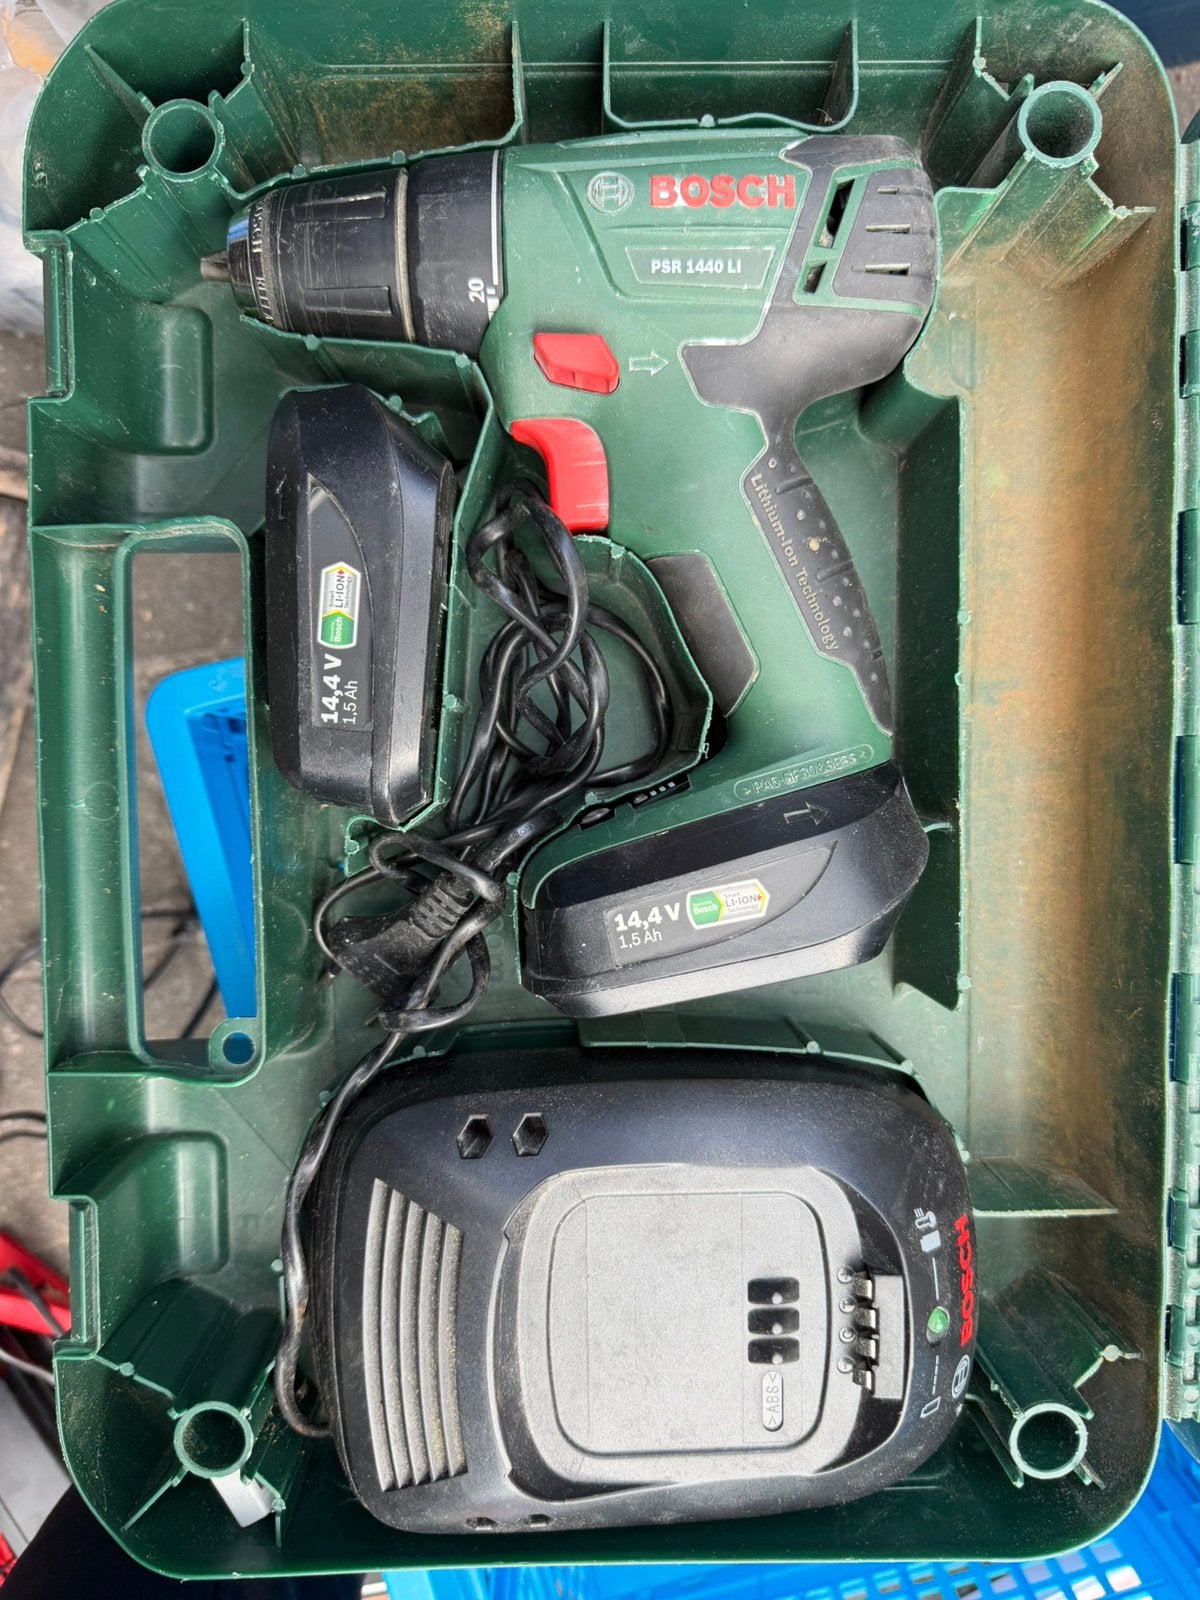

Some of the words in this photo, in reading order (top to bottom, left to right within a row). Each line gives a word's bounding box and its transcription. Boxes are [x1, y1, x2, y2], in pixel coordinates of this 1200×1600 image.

[649, 174, 796, 209] BOSCH
[651, 258, 682, 274] PSR
[686, 258, 724, 274] 1440
[727, 259, 742, 274] LI
[468, 277, 485, 304] 20
[750, 472, 799, 568] Lithium-Ion
[795, 565, 840, 650] Technology
[334, 616, 343, 643] Bosch
[323, 652, 342, 671] V
[320, 674, 344, 724] 14,4
[344, 680, 359, 700] Ah
[342, 702, 358, 725] 1,5
[614, 906, 663, 932] 14,4
[664, 902, 681, 921] V
[692, 903, 719, 914] Bosch
[618, 932, 642, 949] 1,5
[644, 928, 663, 944] Ah
[953, 1212, 975, 1348] BOSCH
